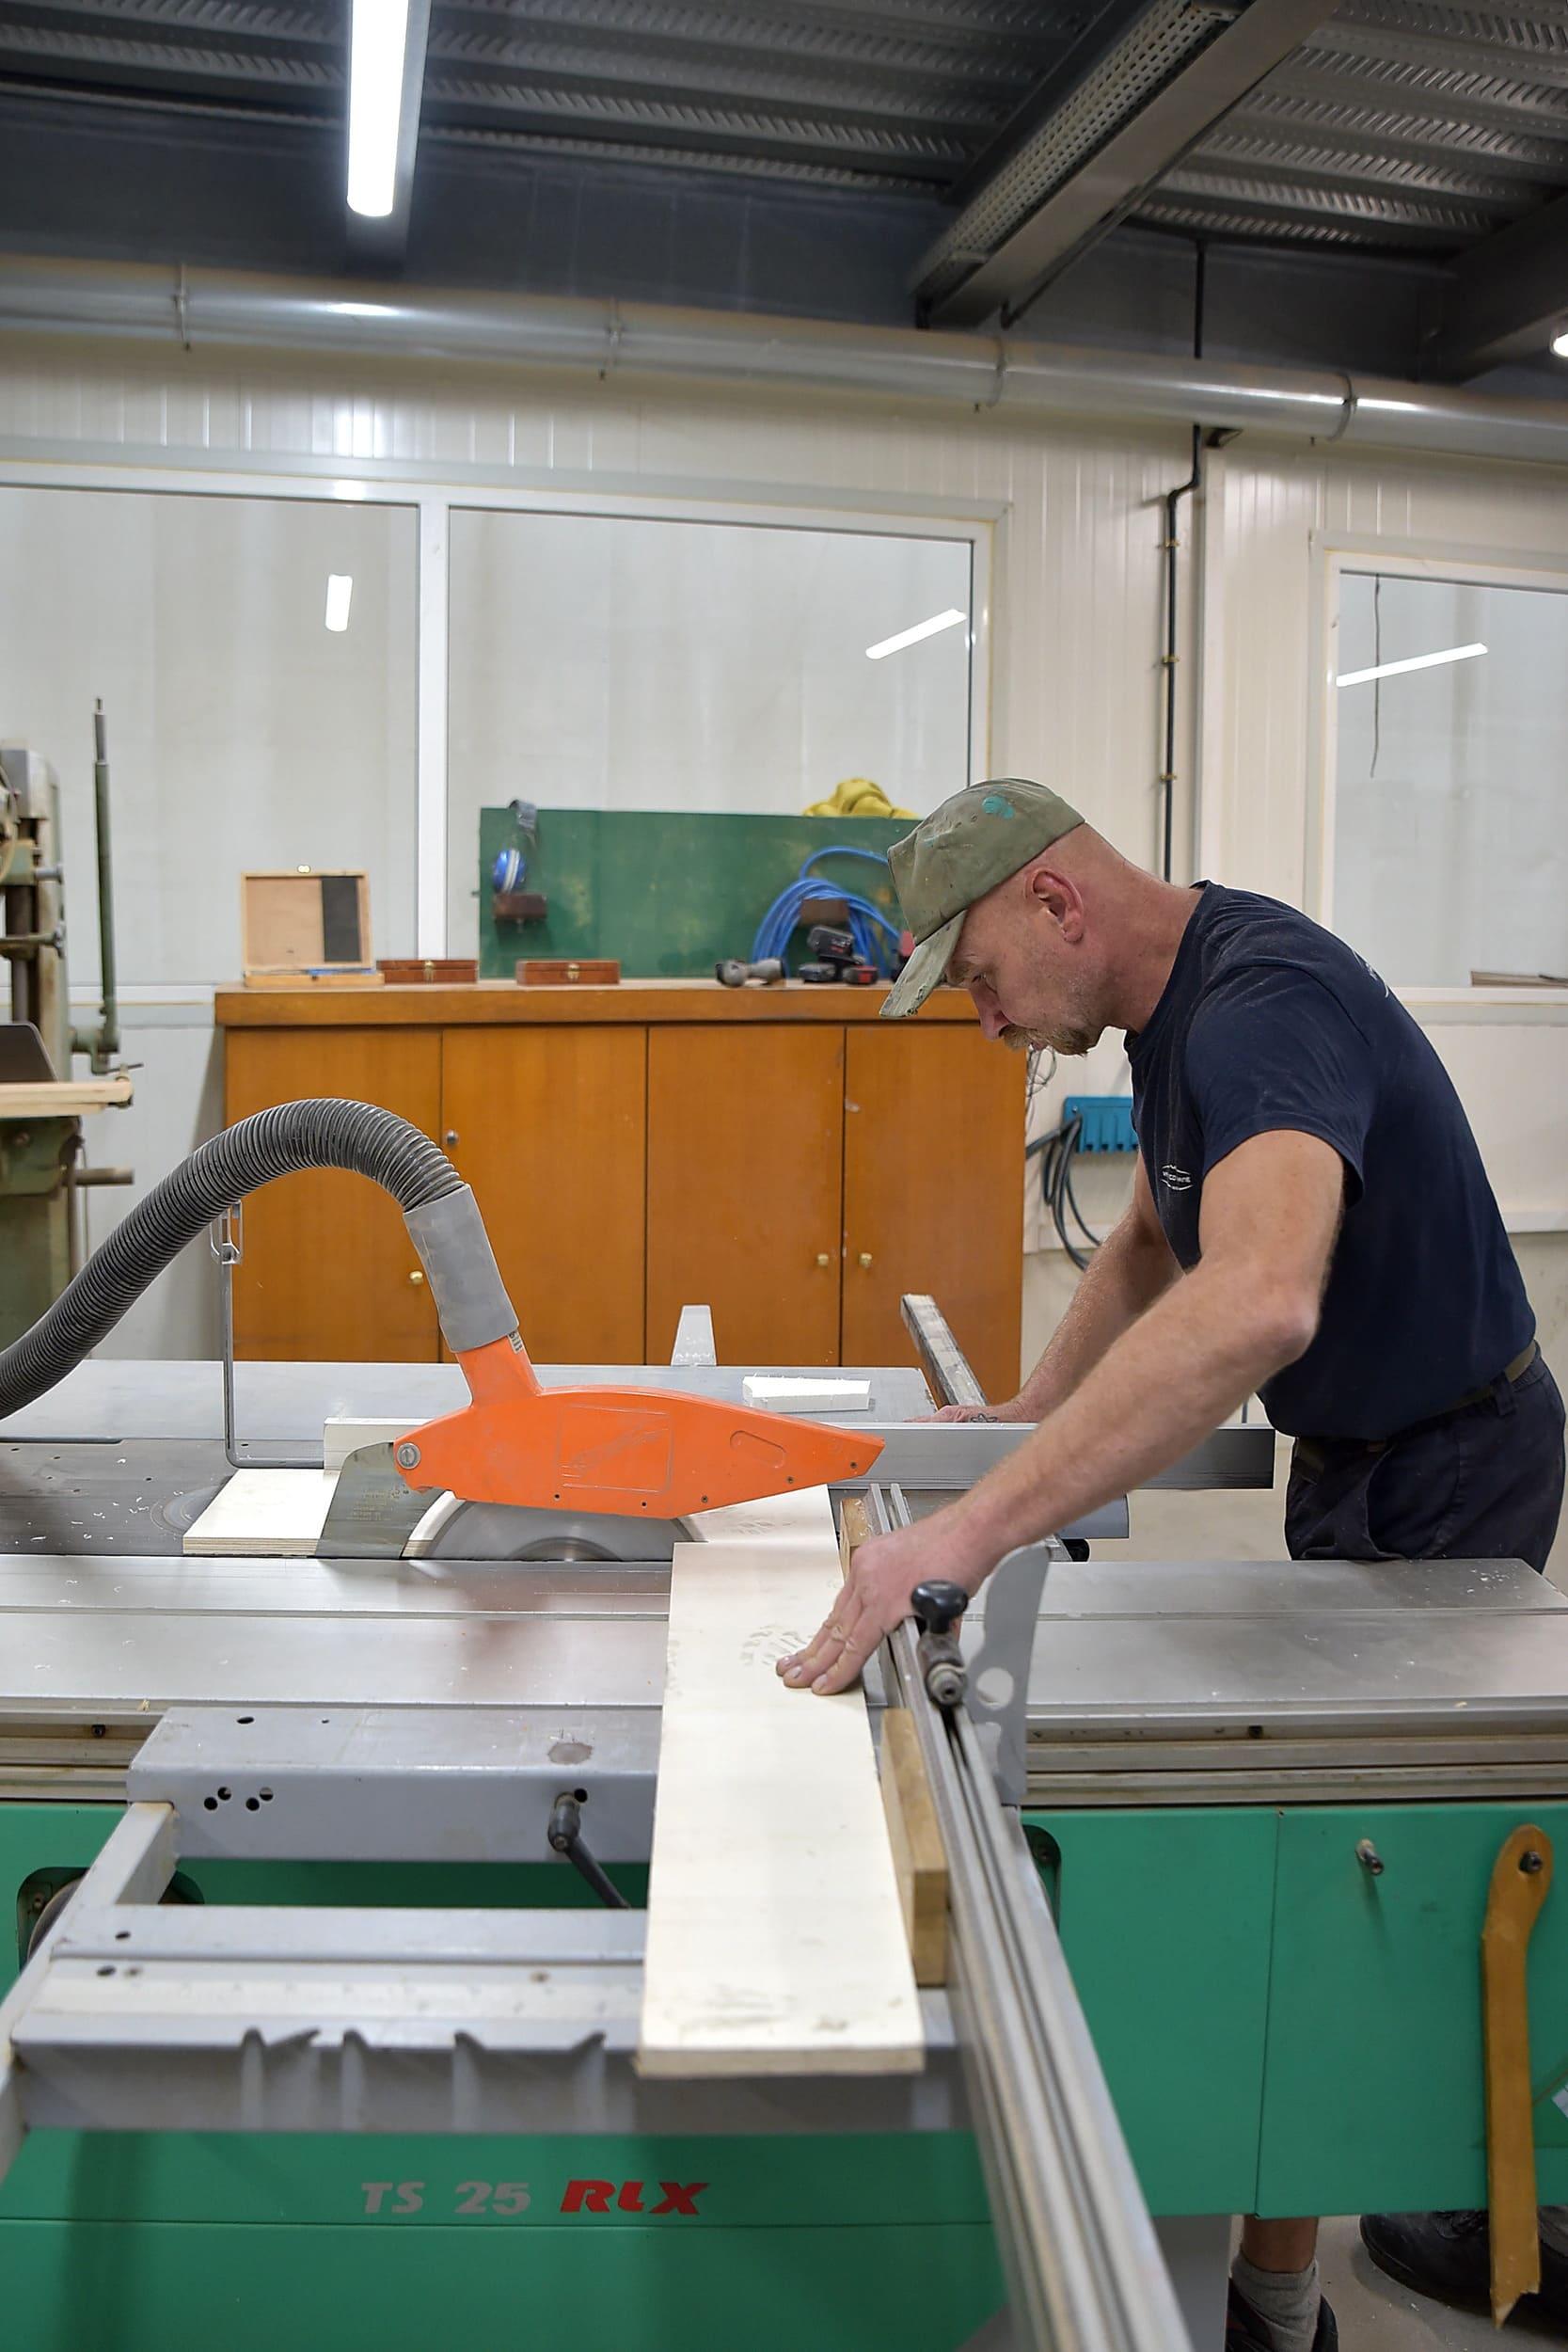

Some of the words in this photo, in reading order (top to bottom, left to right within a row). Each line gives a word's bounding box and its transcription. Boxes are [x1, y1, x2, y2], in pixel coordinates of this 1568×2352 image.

[361, 2182, 425, 2214] TS
[454, 2181, 531, 2216] 25
[560, 2179, 710, 2216] RLX
